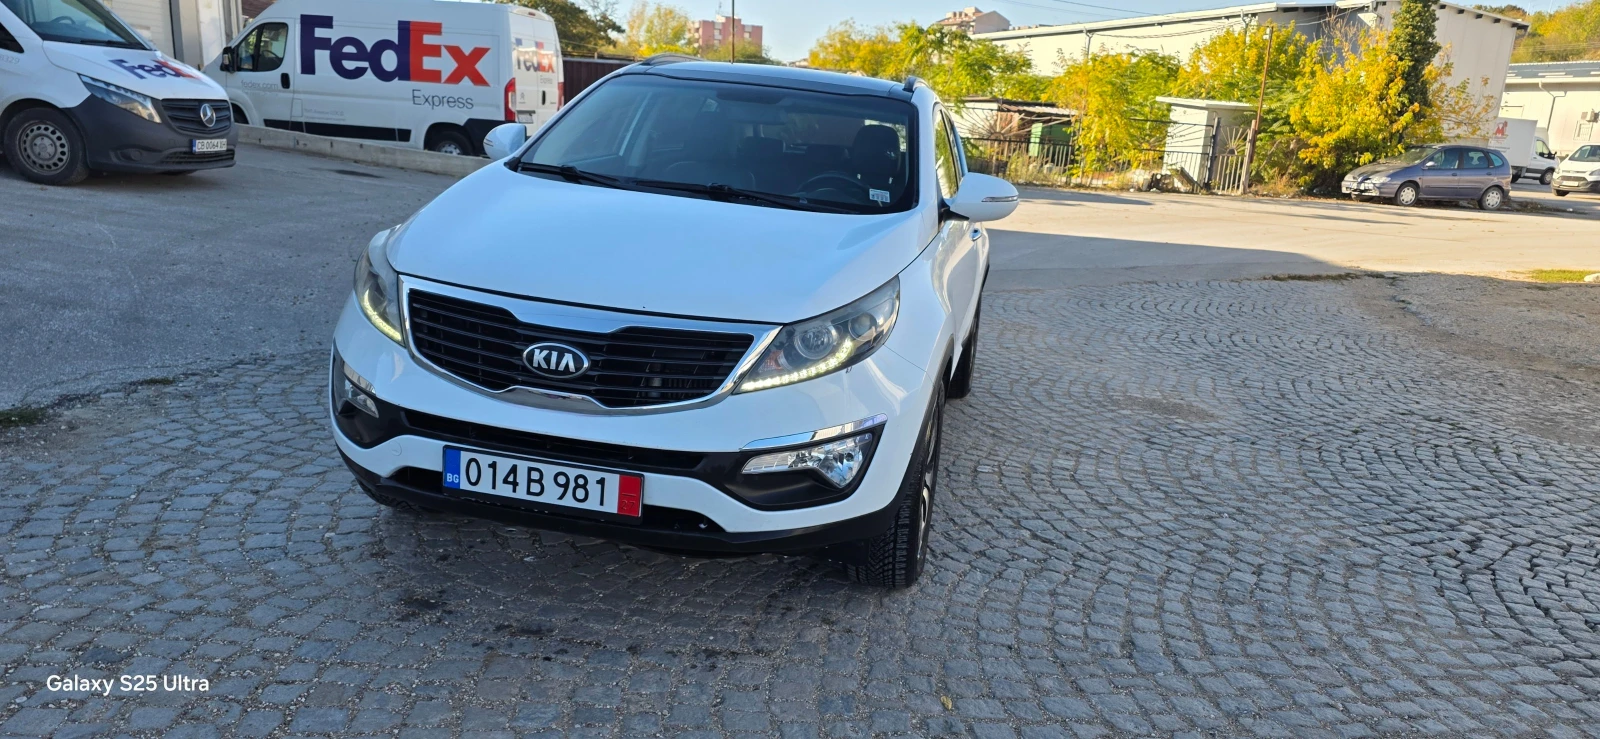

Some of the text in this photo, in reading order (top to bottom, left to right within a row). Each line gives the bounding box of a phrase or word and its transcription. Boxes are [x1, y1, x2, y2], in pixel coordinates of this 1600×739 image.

[300, 14, 491, 87] FedEx
[412, 89, 474, 110] Express
[532, 348, 576, 373] KIA
[446, 472, 459, 484] BG
